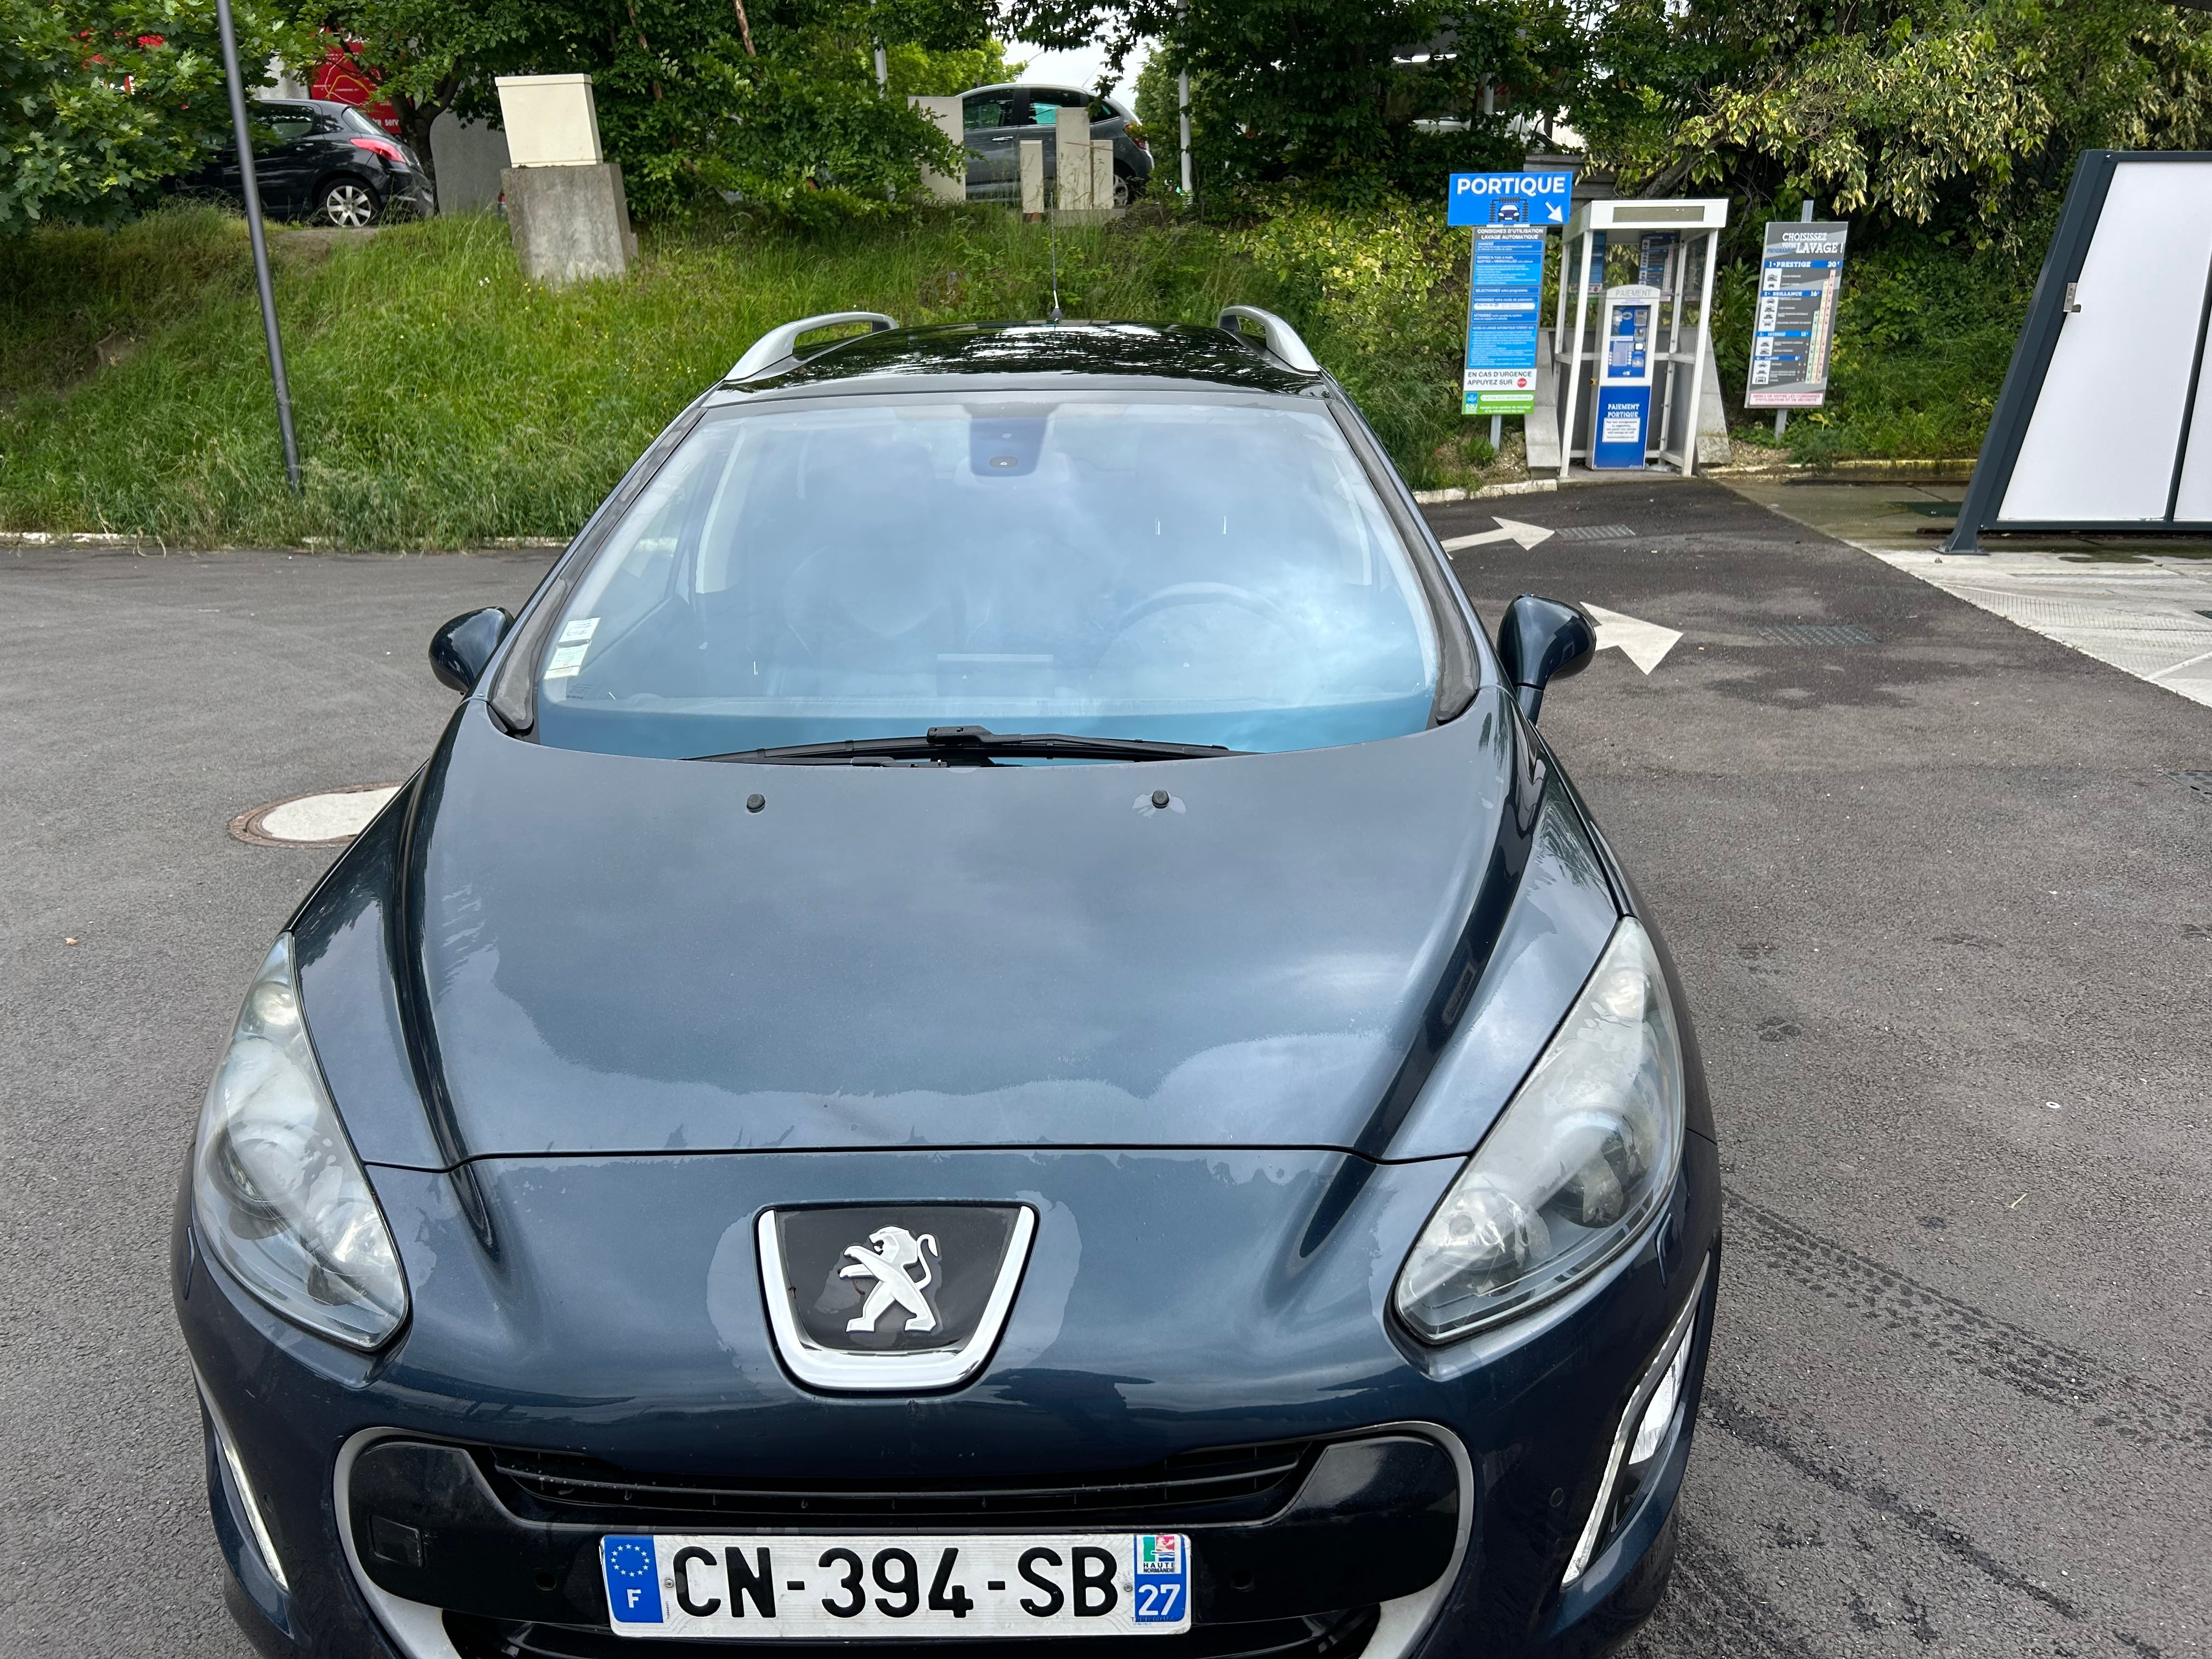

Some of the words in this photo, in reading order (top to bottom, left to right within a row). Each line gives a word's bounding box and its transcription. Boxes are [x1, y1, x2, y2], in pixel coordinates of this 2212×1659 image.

[1457, 177, 1565, 196] PORTIQUE
[1782, 233, 1827, 241] CHOISISSEZ
[1796, 242, 1838, 253] LAVAGE
[673, 1545, 1119, 1618] CN-394-SB
[627, 1589, 641, 1608] F
[1138, 1584, 1181, 1616] 27
